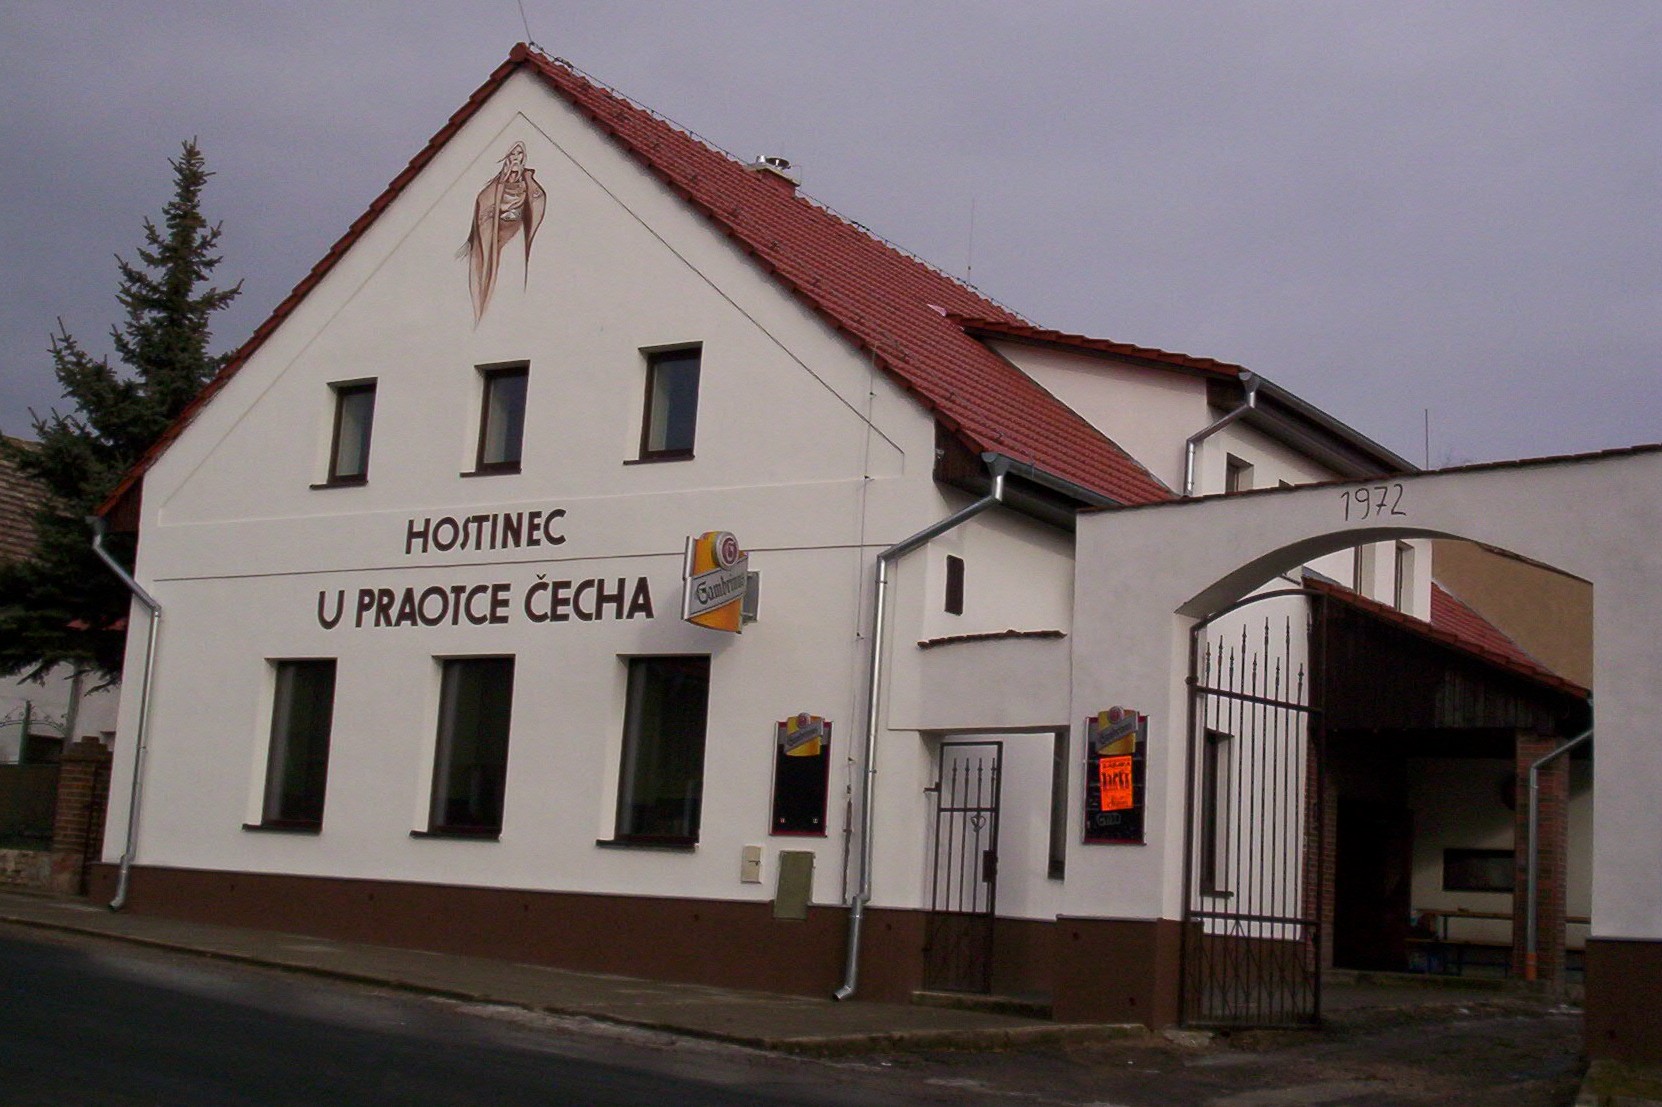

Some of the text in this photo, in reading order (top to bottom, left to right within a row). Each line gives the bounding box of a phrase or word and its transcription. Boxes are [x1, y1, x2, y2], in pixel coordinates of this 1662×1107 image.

[1340, 483, 1407, 521] 1972
[405, 508, 567, 555] HOSTINEC
[317, 573, 655, 630] U PRAOTCE ČECHA
